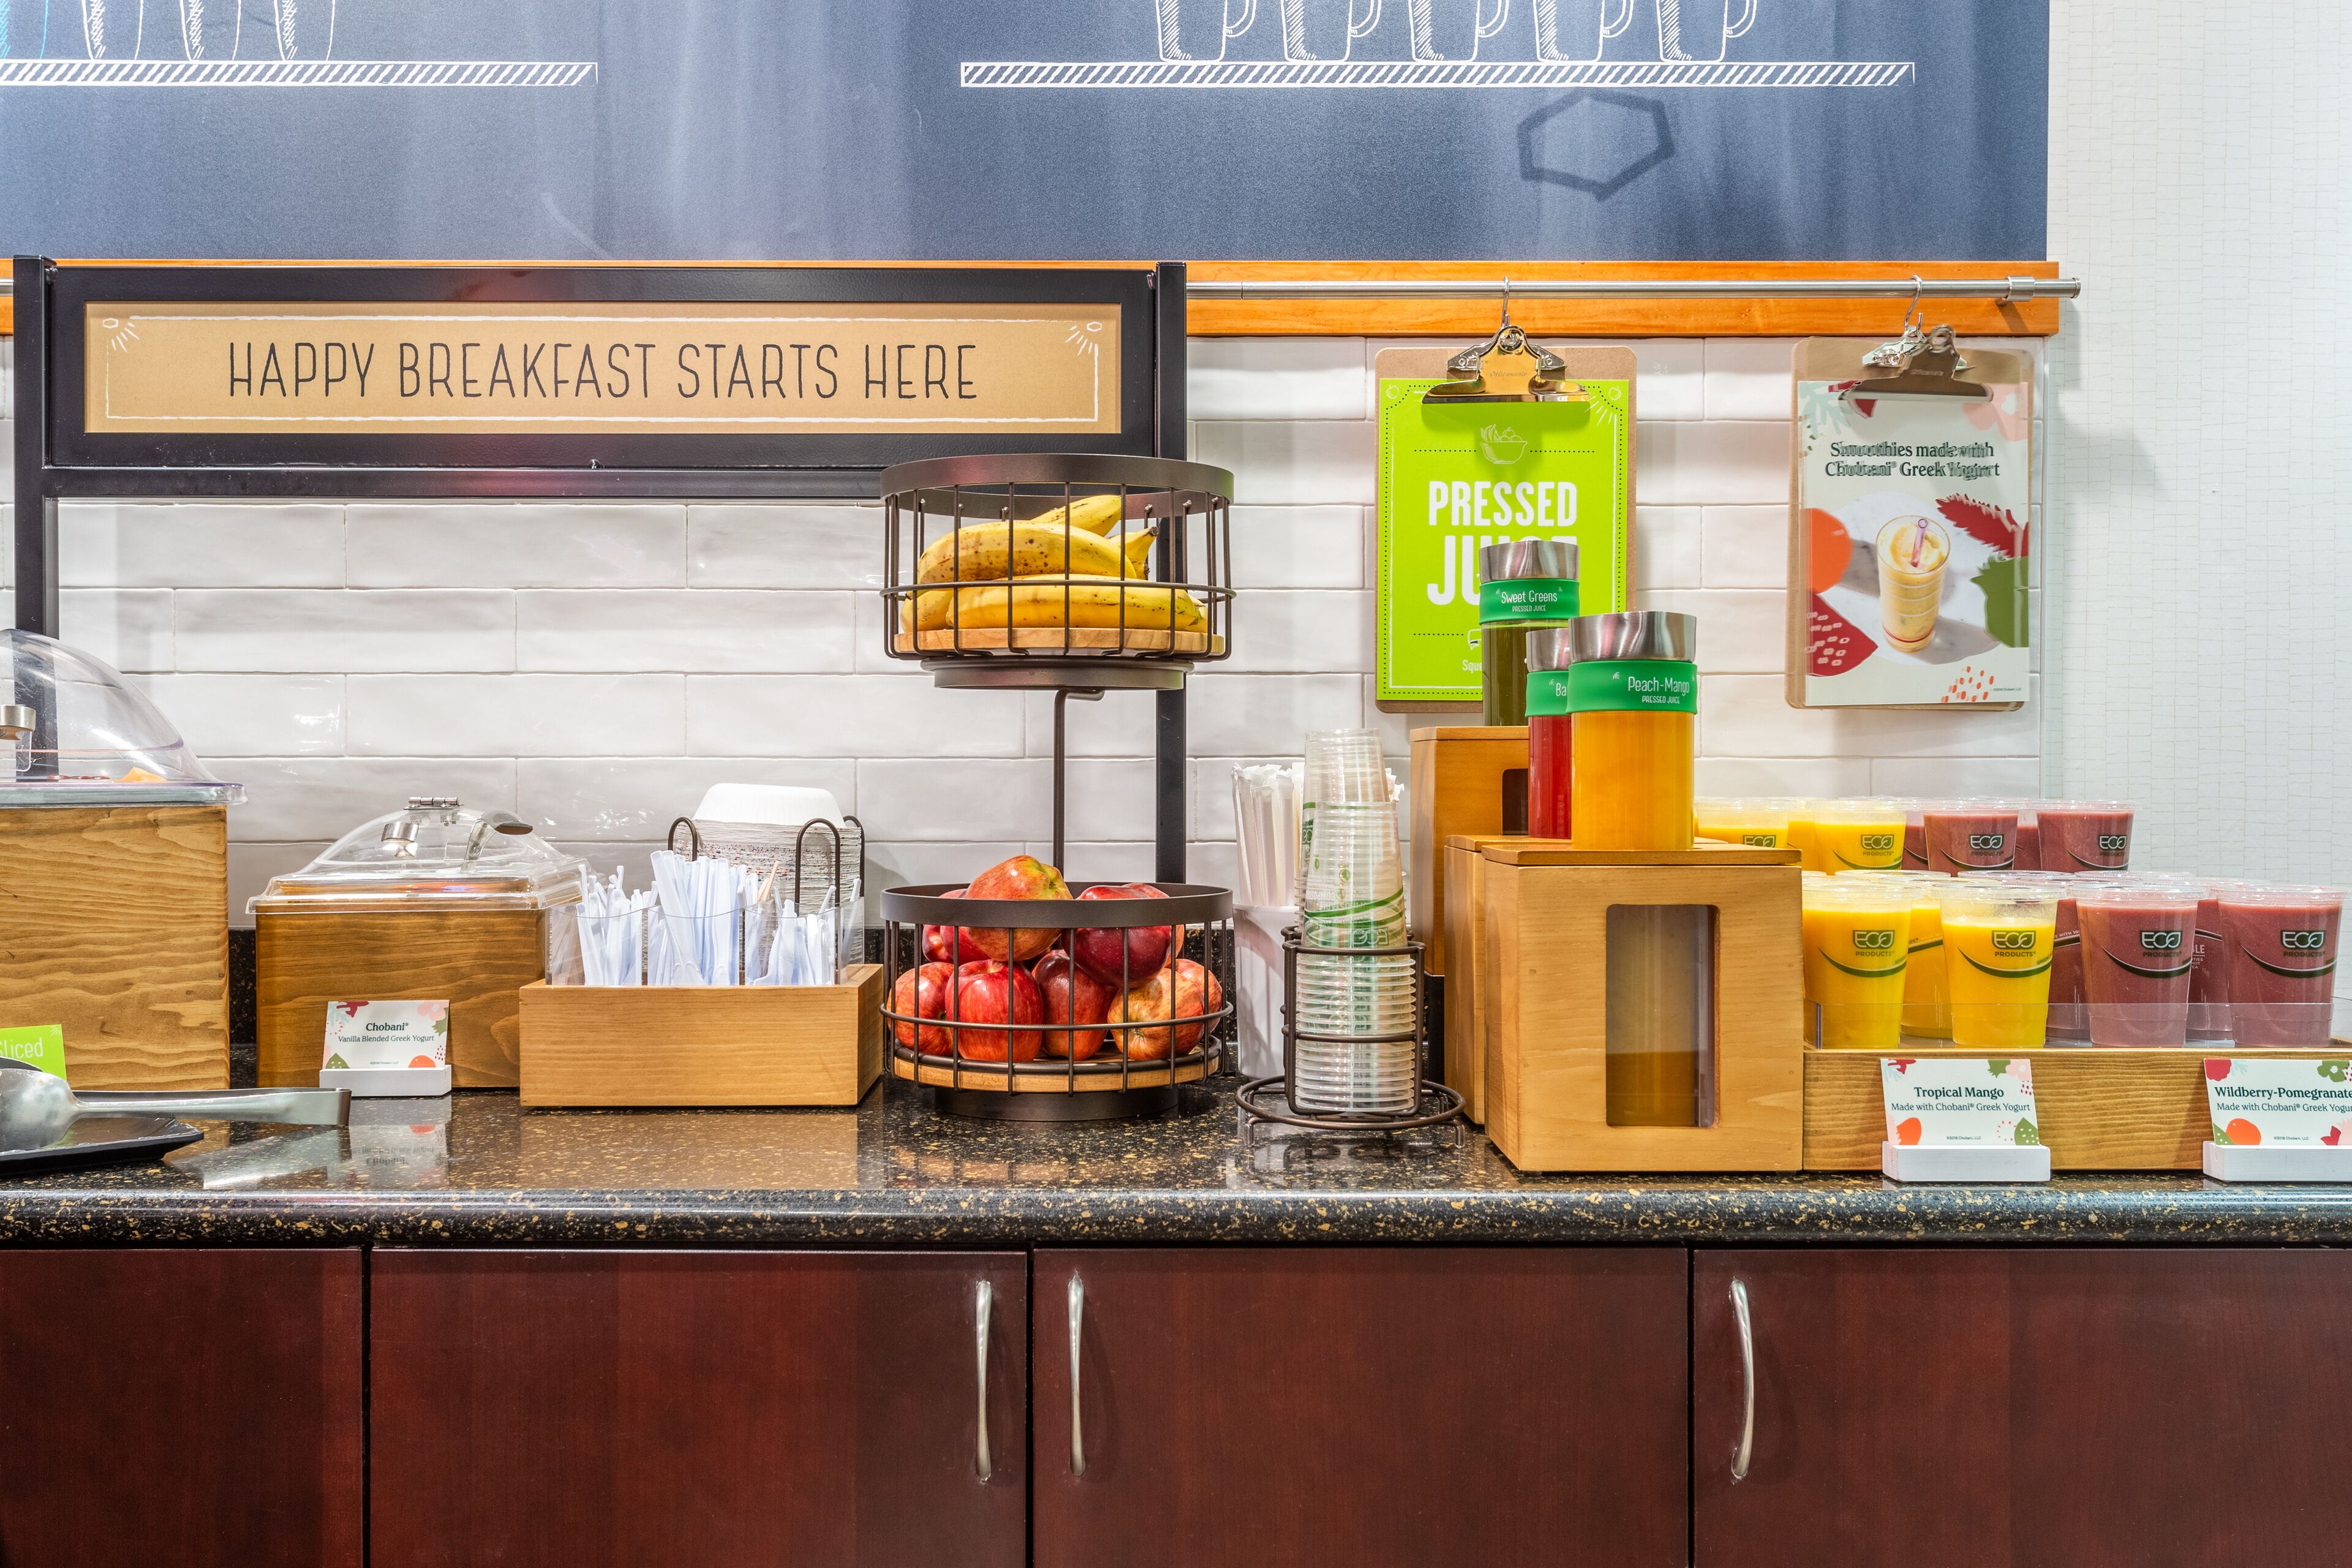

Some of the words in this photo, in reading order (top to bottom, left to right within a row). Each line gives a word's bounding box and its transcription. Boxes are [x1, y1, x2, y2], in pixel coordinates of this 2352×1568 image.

[230, 342, 375, 398] HAPPY
[399, 342, 656, 398] BREAKFAST
[677, 344, 838, 399] STARTS
[865, 344, 978, 399] HERE
[1900, 461, 1947, 477] Greek
[1428, 480, 1578, 527] PRESSED
[1501, 591, 1526, 603] Sweet
[1529, 590, 1558, 602] Greens
[1628, 676, 1689, 696] Peach-Mango
[1642, 695, 1667, 704] PRESSED
[1667, 696, 1681, 704] JUICE
[1863, 835, 1893, 849] ECO
[1970, 835, 2002, 848] ECO
[2100, 836, 2127, 849] ECO
[1855, 931, 1894, 948] ECO
[1994, 931, 2035, 948] ECO
[2141, 932, 2181, 948] ECO
[2283, 931, 2324, 948] ECO
[1914, 1087, 1962, 1099] Tropical
[1965, 1087, 2004, 1100] Mango
[2003, 1103, 2030, 1113] Yogurt
